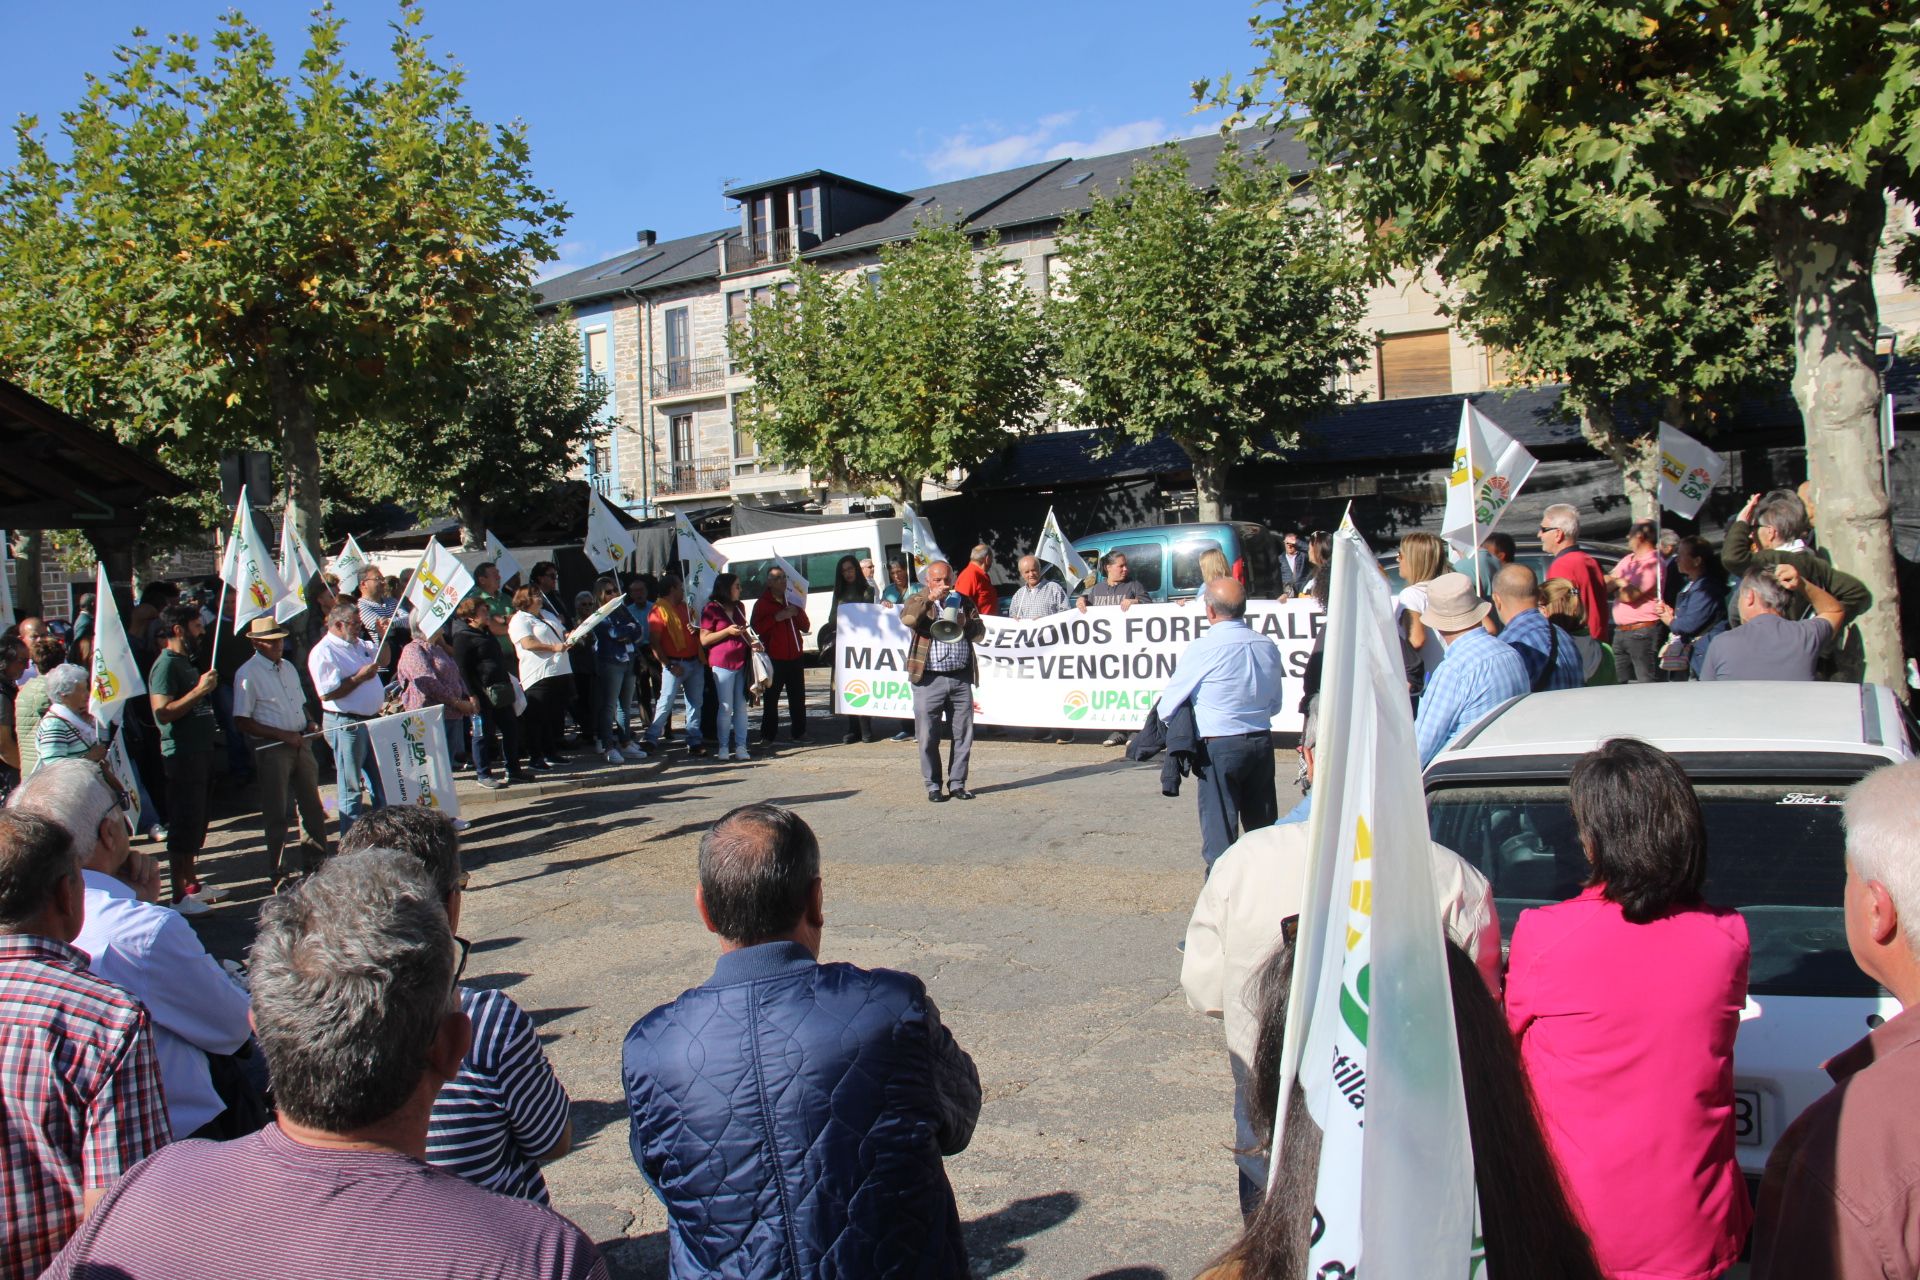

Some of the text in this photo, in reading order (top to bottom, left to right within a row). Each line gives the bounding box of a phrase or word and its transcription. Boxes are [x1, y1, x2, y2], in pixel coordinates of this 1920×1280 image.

[1475, 505, 1495, 526] PA
[977, 612, 1327, 649] CENDIOS FORETALE
[977, 647, 1177, 679] PREVENCIÓN
[872, 680, 912, 701] UPA
[412, 742, 432, 807] UPA COA
[398, 778, 407, 801] CAMPO
[1782, 792, 1827, 804] Ford
